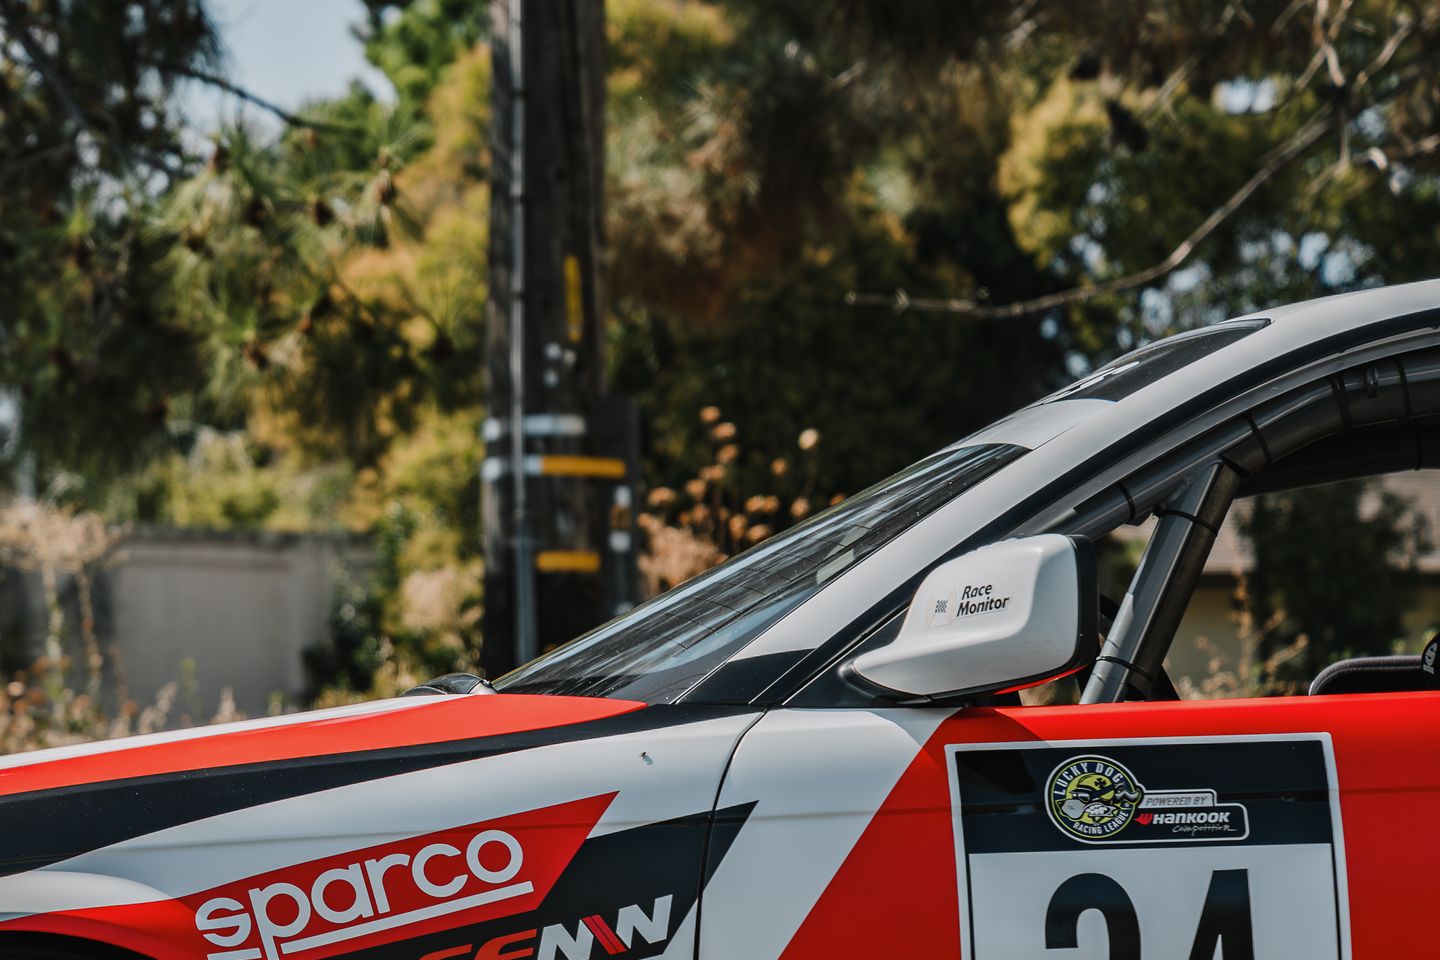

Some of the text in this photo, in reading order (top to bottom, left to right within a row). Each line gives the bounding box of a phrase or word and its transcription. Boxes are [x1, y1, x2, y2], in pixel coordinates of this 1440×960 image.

[962, 584, 993, 600] Race
[956, 597, 1010, 617] Monitor
[1054, 762, 1124, 796] LUCKY DOG
[1146, 796, 1208, 807] POWERED BY
[1073, 810, 1130, 834] RACING LEAGUE
